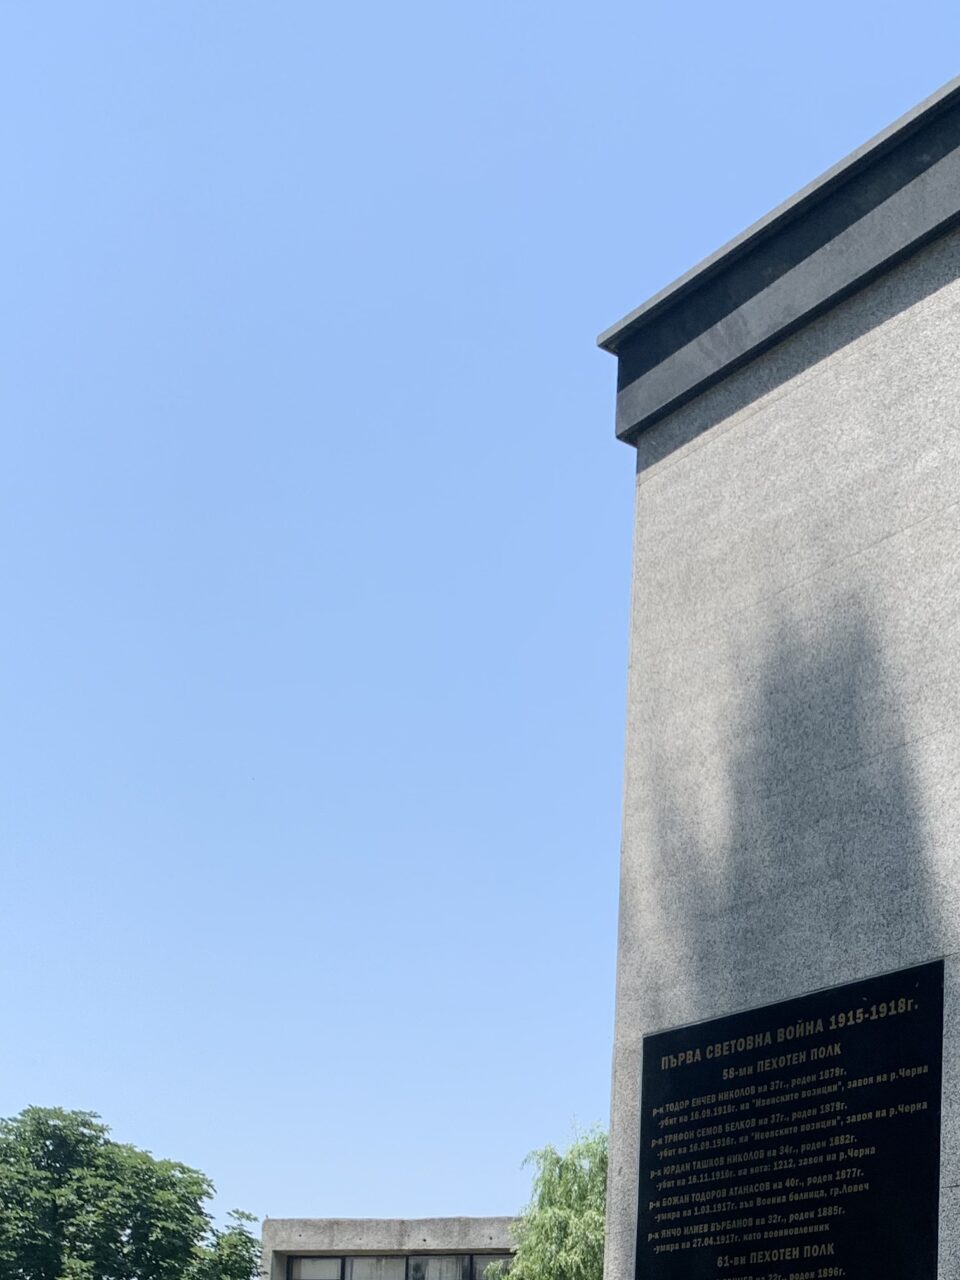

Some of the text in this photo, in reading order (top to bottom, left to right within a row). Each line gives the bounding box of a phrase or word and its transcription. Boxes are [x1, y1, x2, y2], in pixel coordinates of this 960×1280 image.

[661, 994, 918, 1069] ПЪРВА СВЕТОВНА ВОЙНА 1915-1918г.
[722, 1042, 841, 1080] 58-ми ПЕХОТЕН ПОЛК
[716, 1242, 834, 1267] 61-ви ПЕХОТЕН ПОЛК
